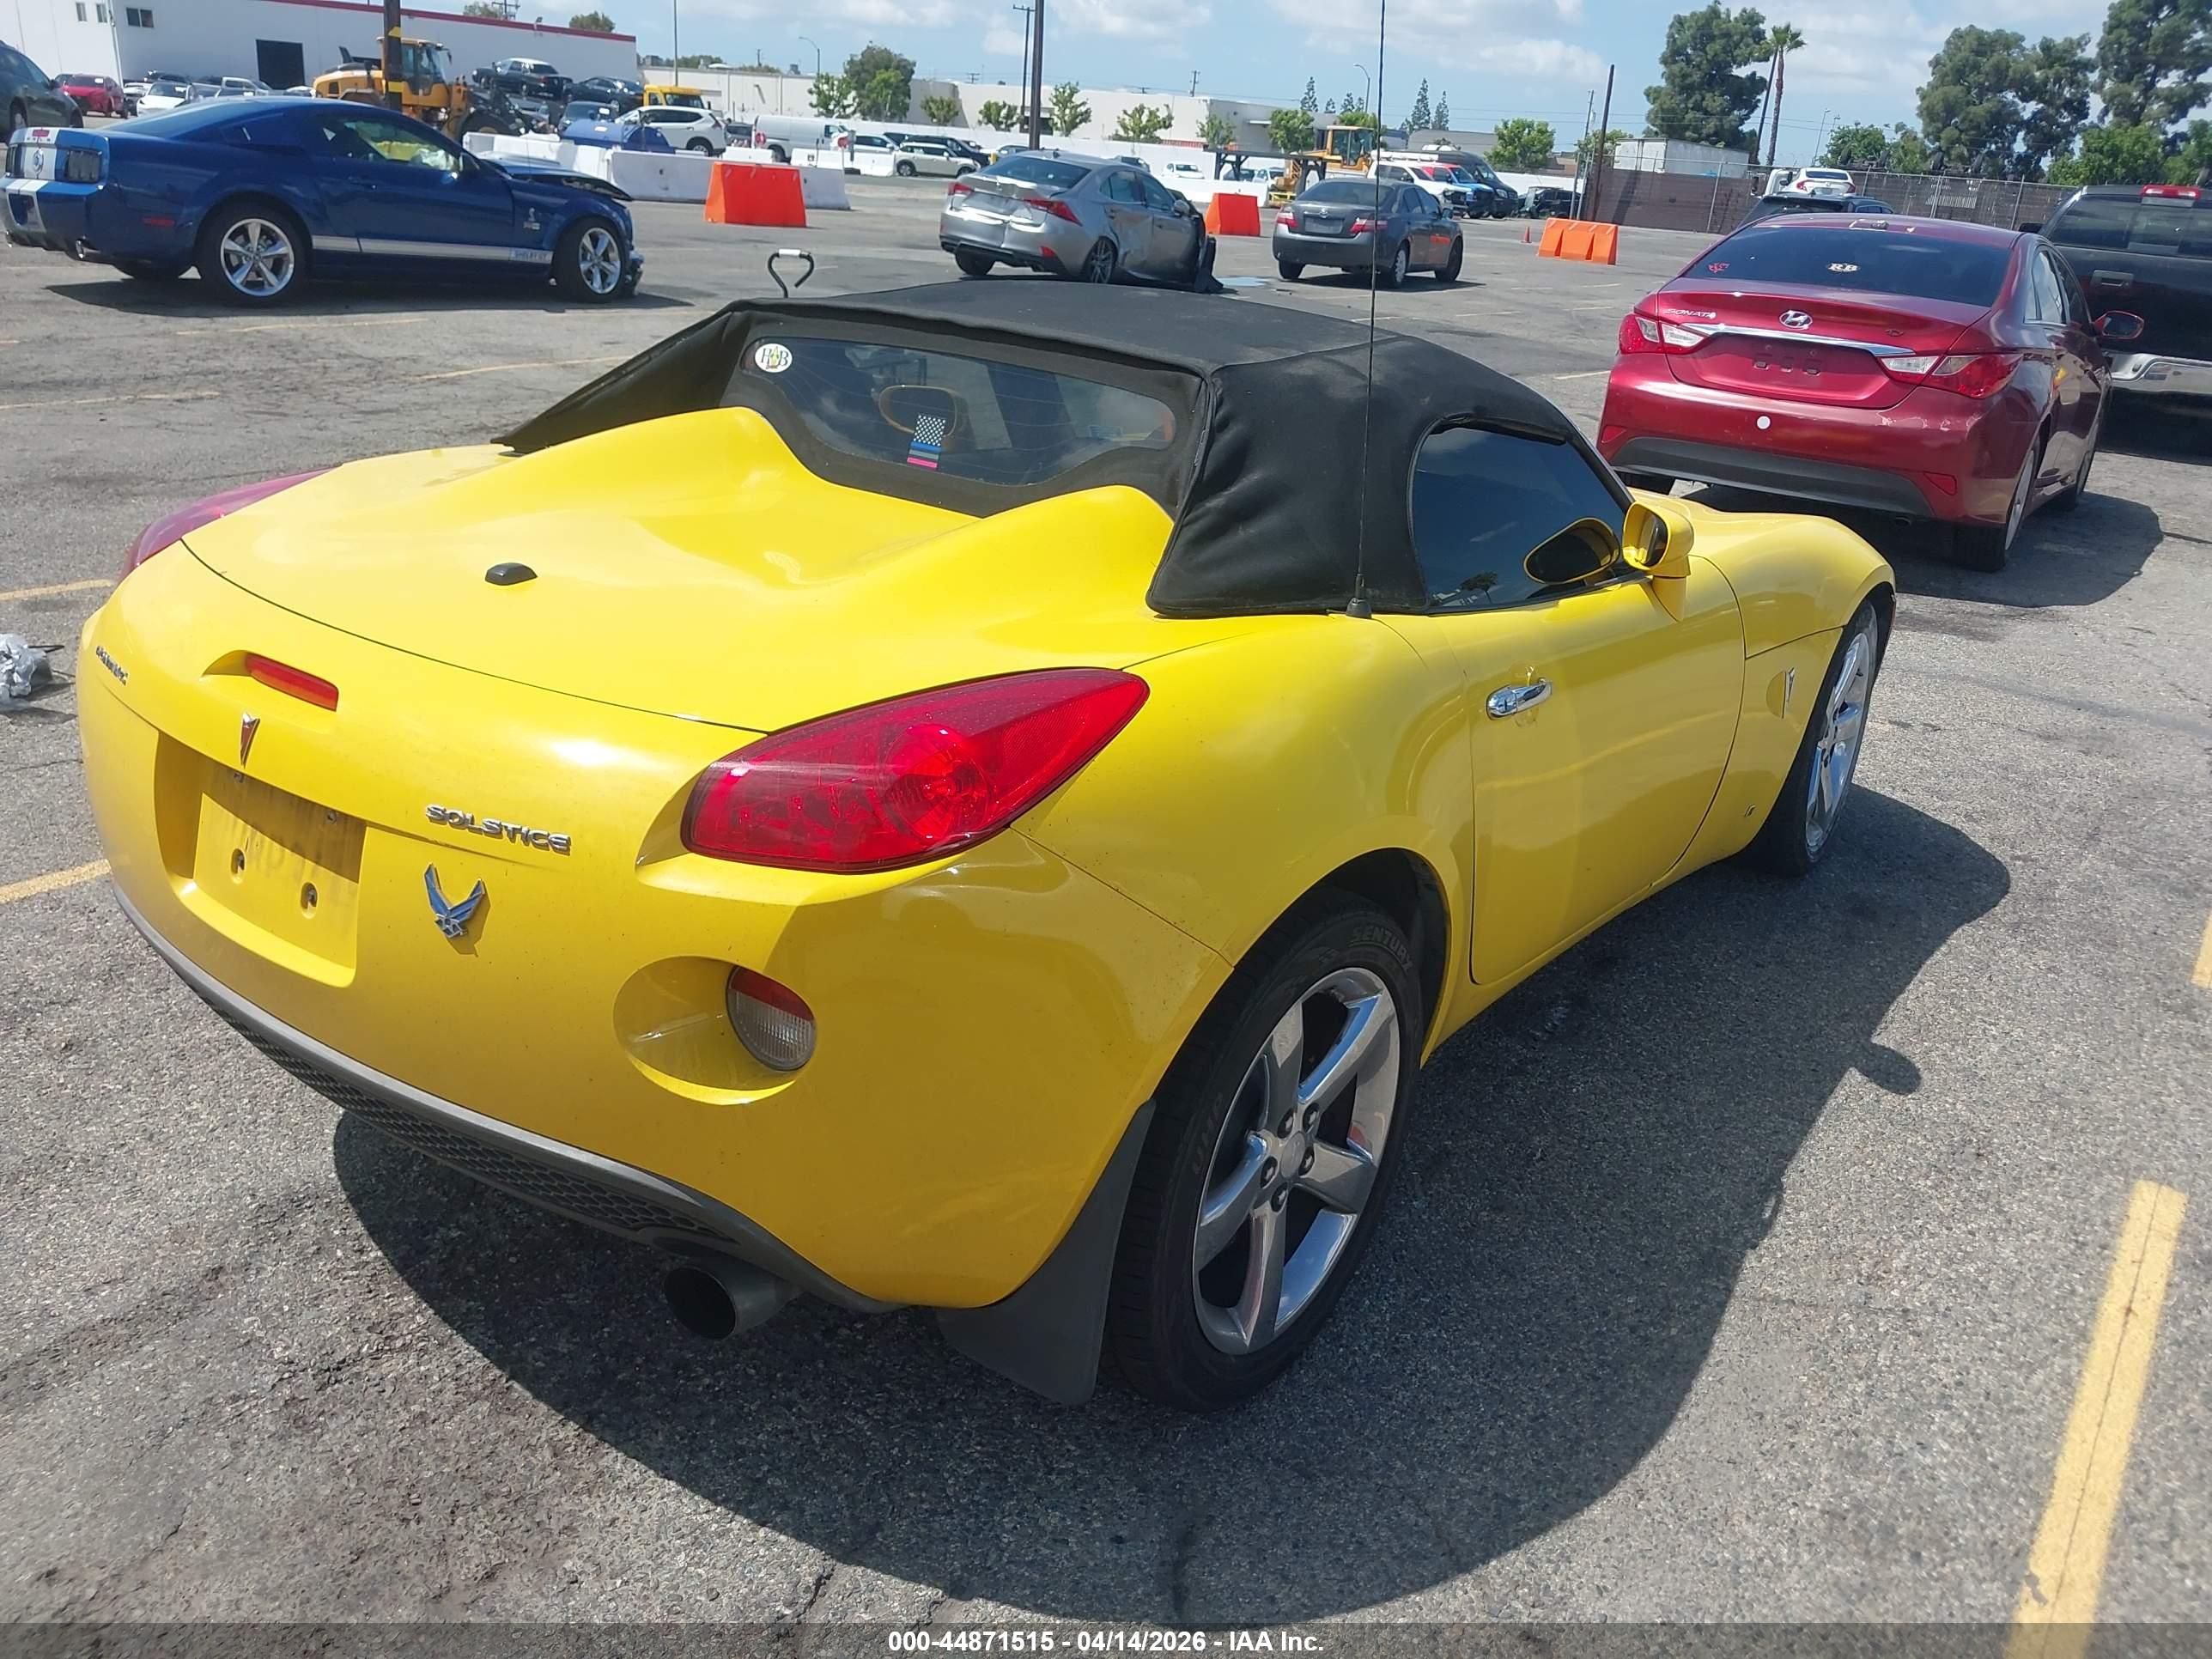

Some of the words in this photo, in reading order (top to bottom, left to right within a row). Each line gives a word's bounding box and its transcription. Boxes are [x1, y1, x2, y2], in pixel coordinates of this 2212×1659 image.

[1663, 308, 1717, 319] SONATA
[426, 803, 572, 856] SOLSTICE
[1350, 924, 1414, 972] SENTURY
